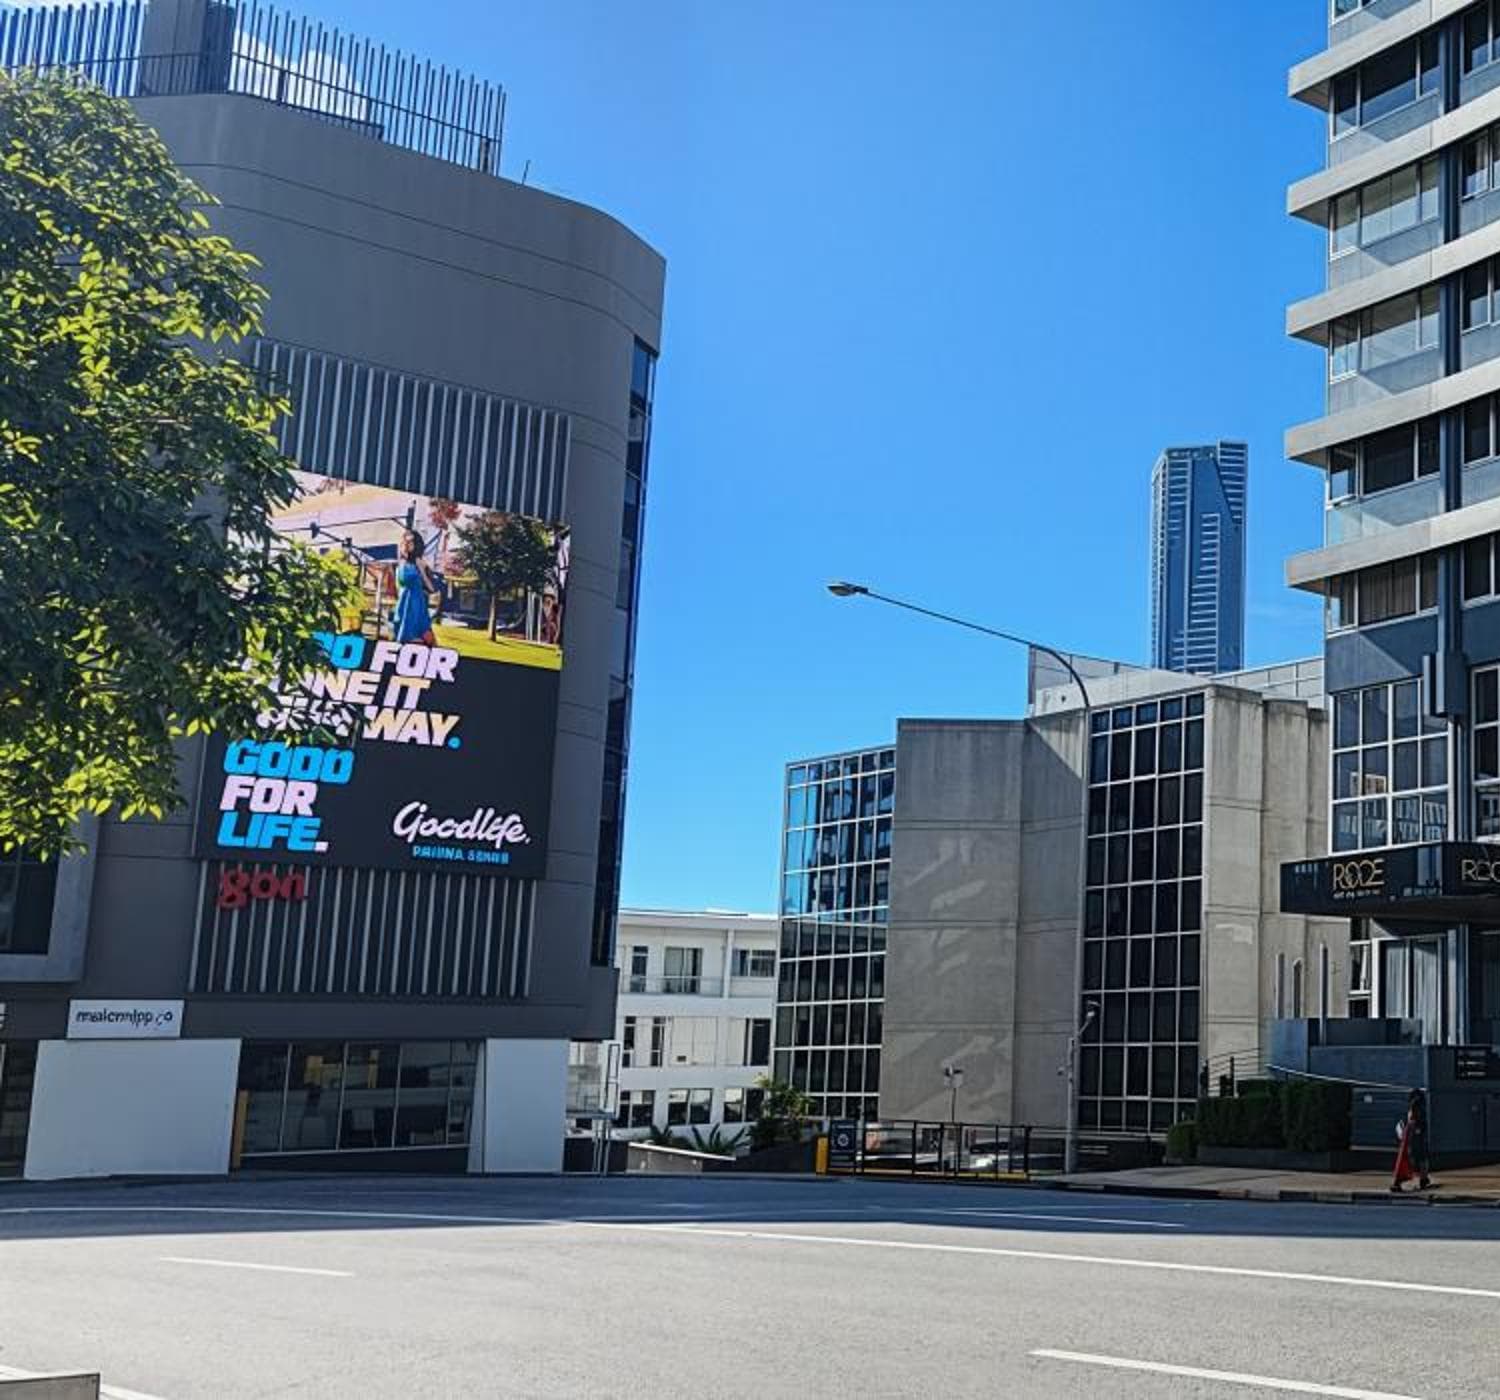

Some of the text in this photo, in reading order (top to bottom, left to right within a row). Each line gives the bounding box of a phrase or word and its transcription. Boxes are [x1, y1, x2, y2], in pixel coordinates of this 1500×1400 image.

[369, 640, 460, 682] FOR
[383, 676, 432, 709] IT
[223, 738, 355, 784] GOOD
[219, 774, 318, 816] FOR
[217, 811, 329, 852] LIFE.
